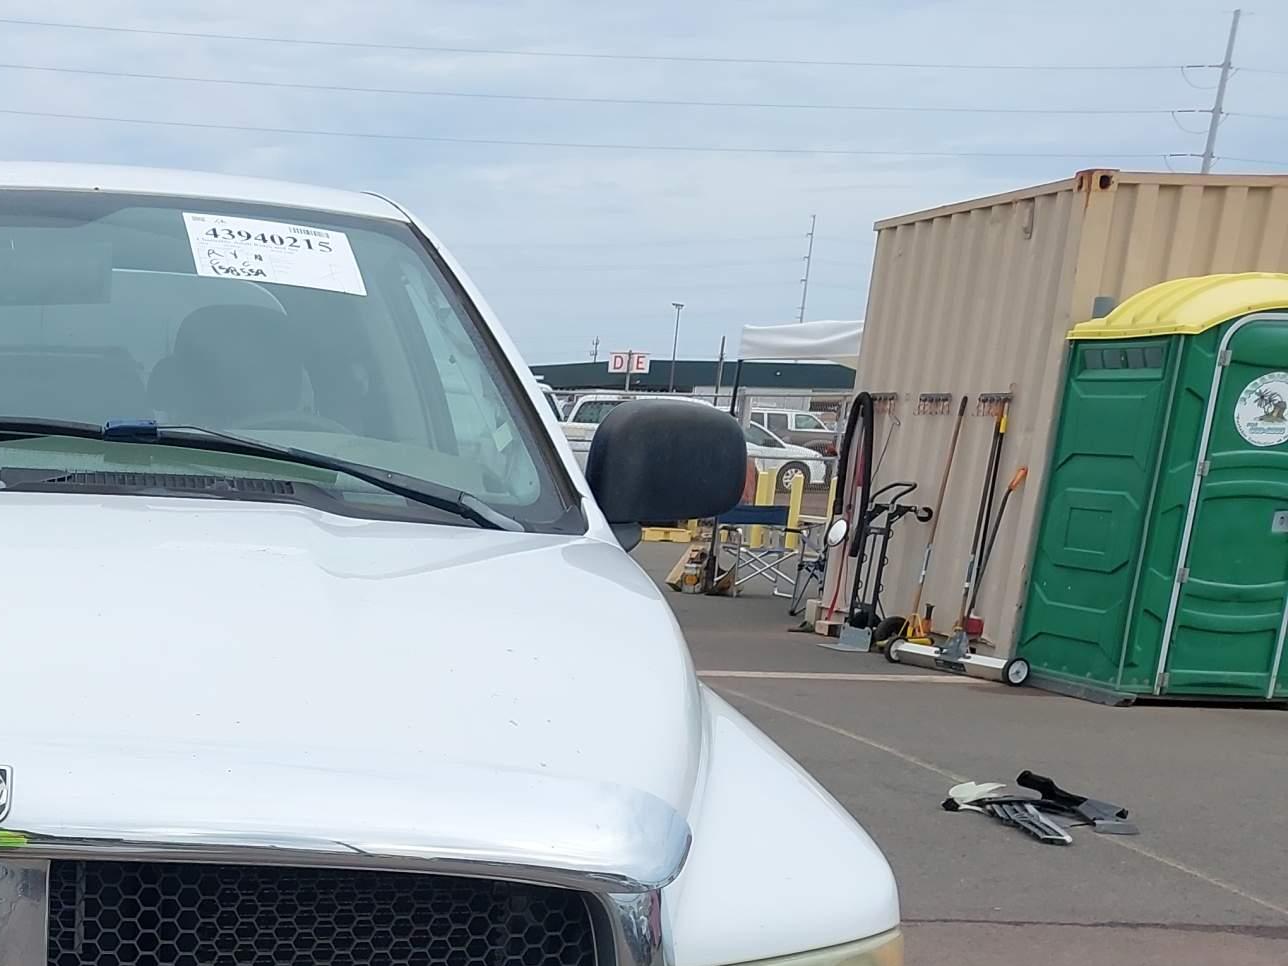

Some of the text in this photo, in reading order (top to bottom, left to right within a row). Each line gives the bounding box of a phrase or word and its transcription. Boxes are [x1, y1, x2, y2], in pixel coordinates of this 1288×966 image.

[205, 227, 333, 253] 43940215
[613, 355, 646, 370] D E
